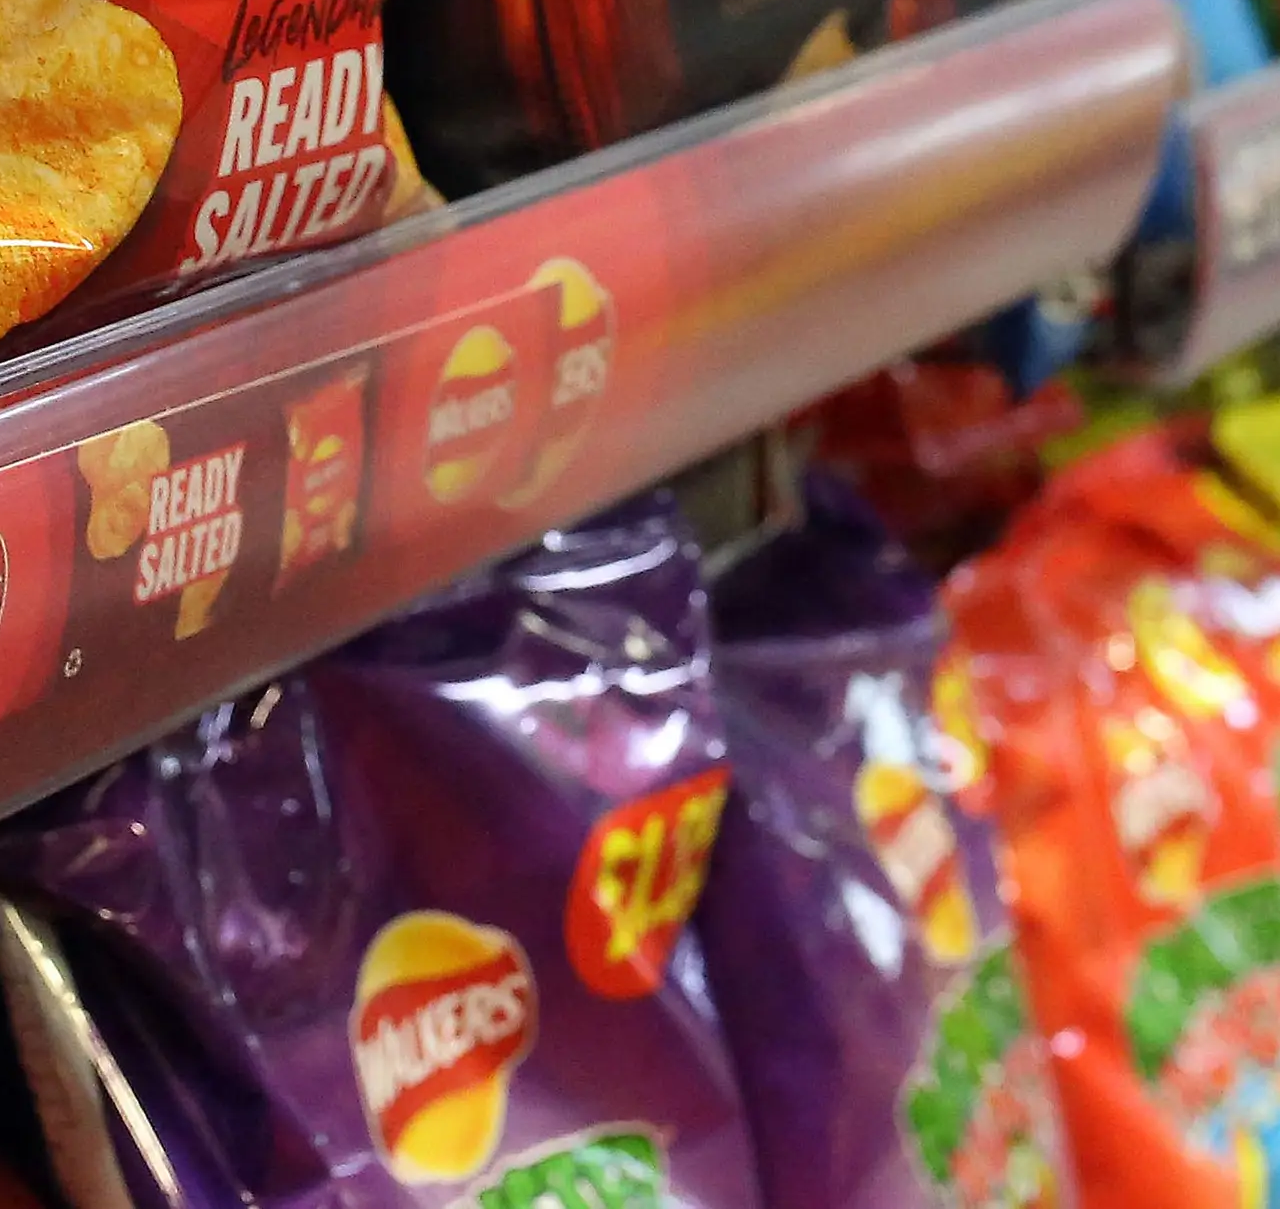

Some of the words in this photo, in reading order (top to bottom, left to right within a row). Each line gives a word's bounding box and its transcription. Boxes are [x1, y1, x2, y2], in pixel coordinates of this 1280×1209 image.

[219, 43, 383, 178] READY
[179, 143, 387, 271] SALTED
[146, 451, 245, 535] READY
[135, 510, 245, 603] SALTED
